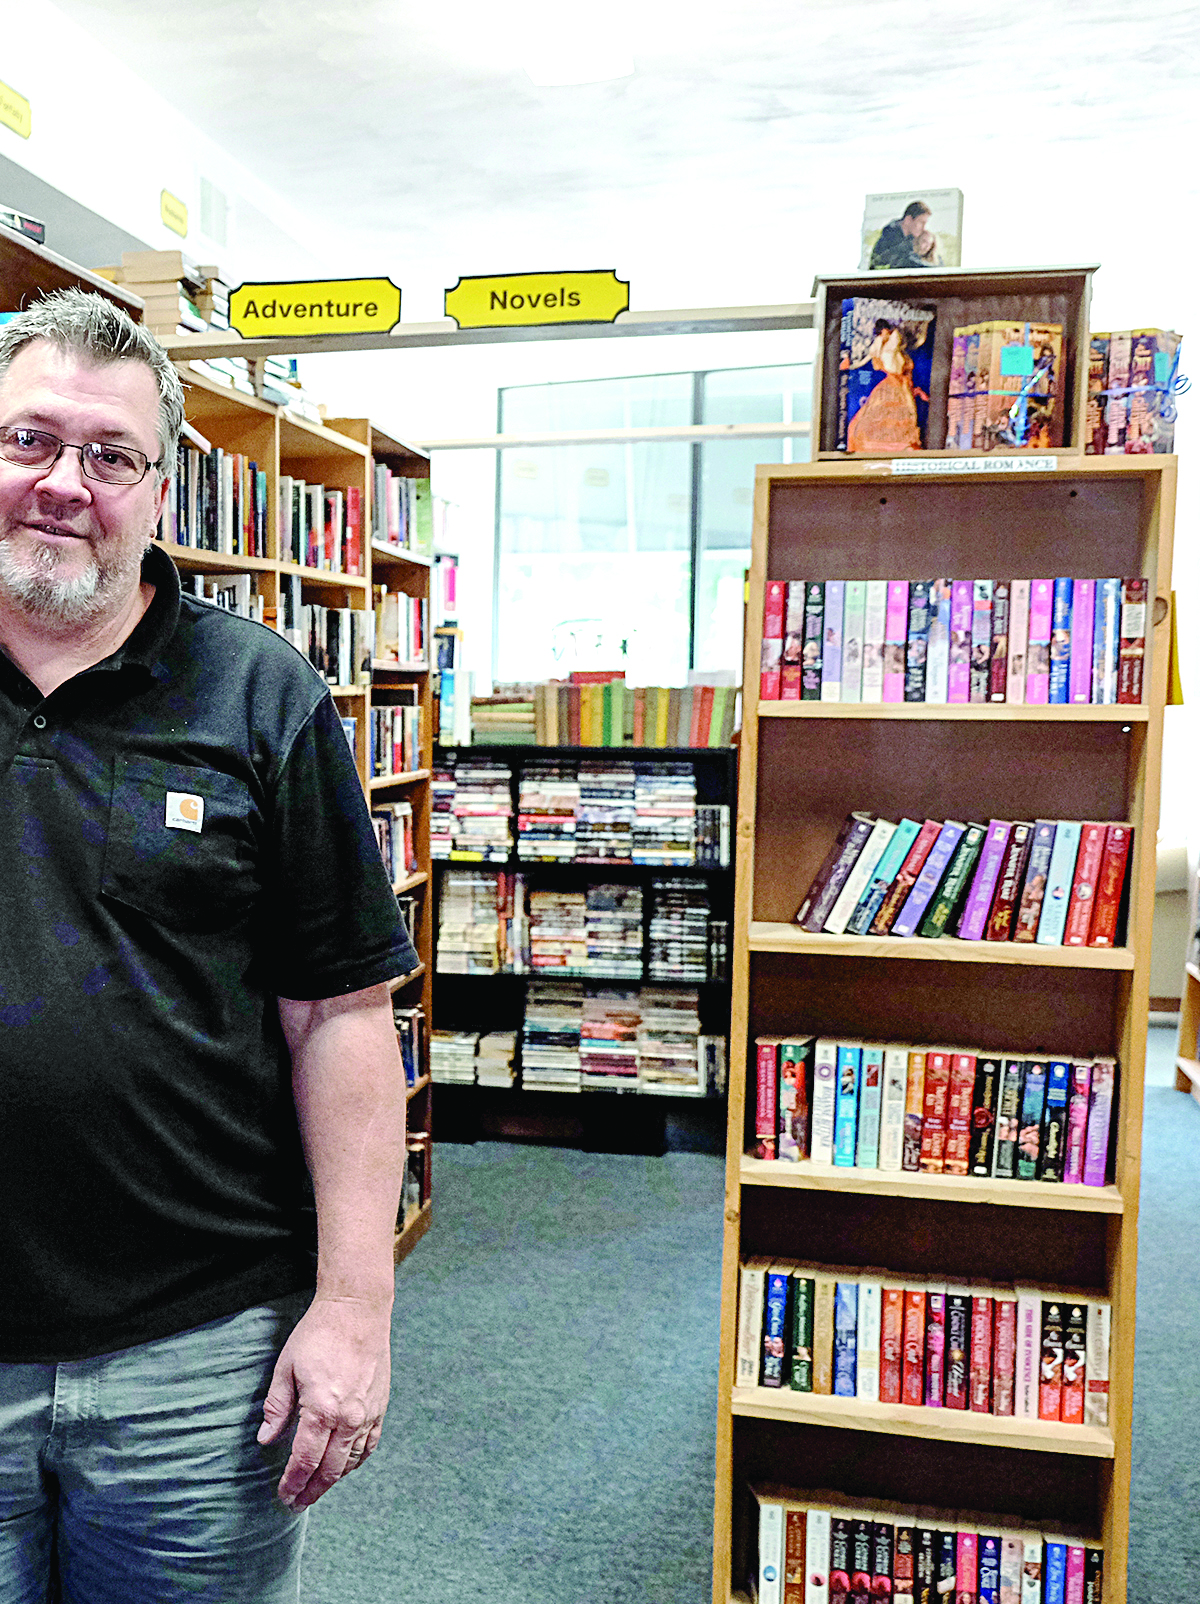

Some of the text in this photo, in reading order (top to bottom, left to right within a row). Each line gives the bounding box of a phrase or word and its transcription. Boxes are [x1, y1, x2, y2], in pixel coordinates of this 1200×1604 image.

[244, 299, 378, 319] Adventure
[490, 288, 581, 310] Novels
[895, 460, 980, 472] HISTORICAL
